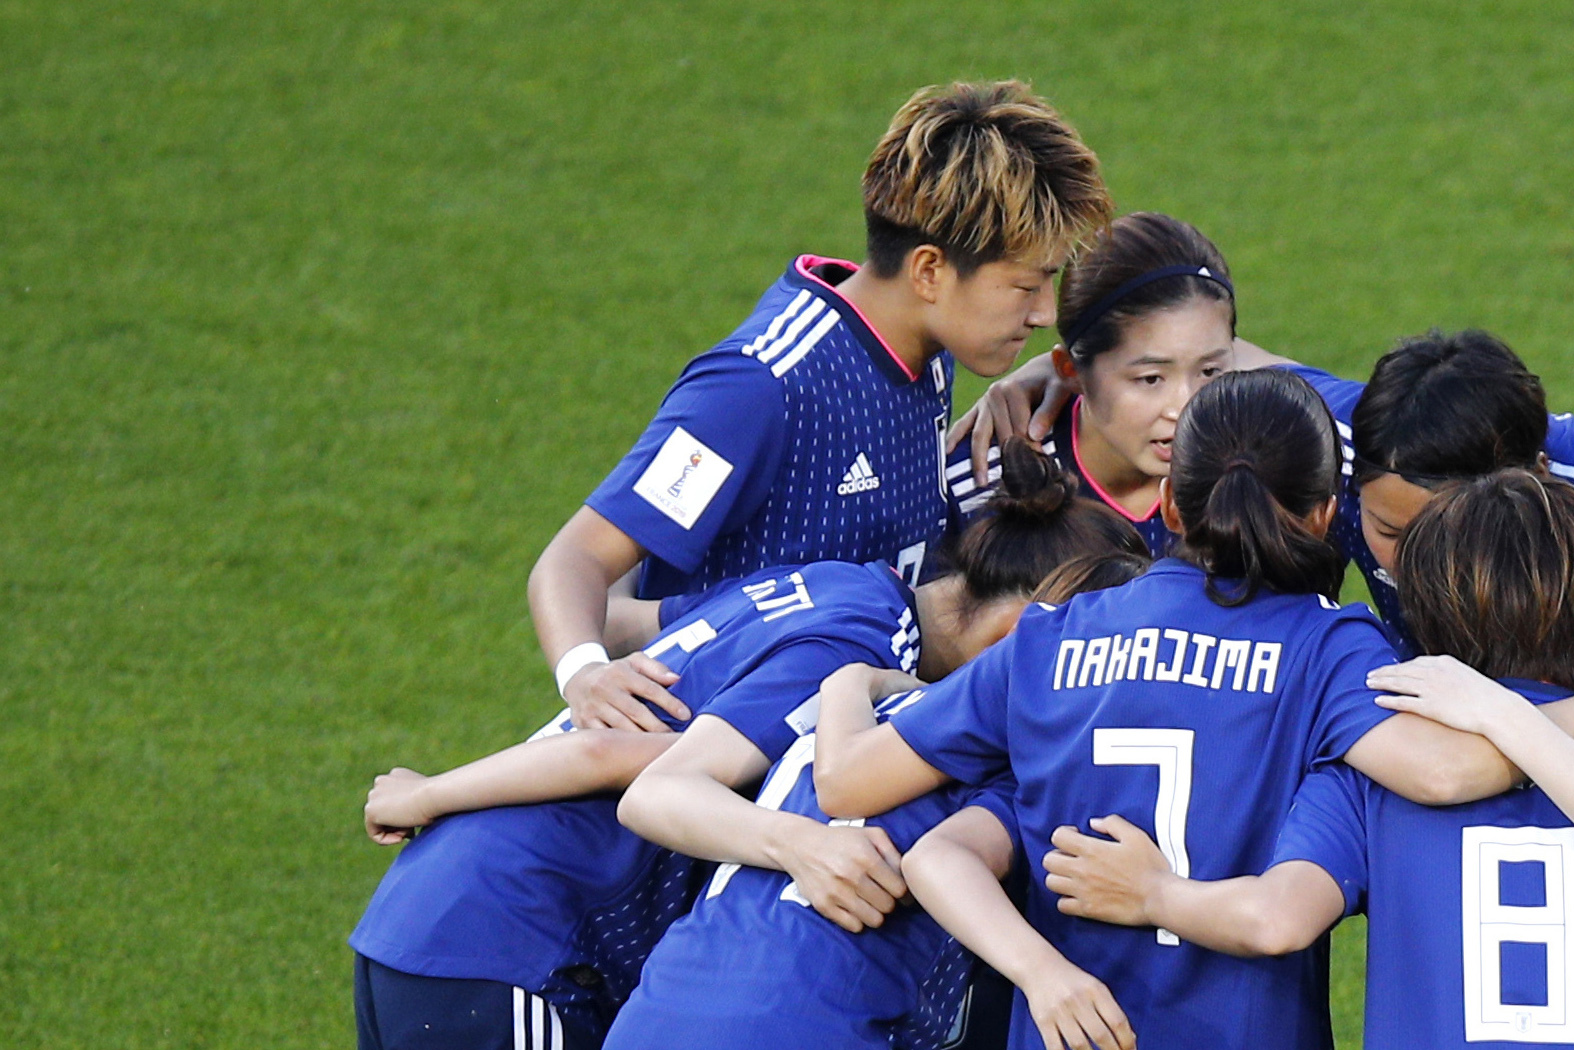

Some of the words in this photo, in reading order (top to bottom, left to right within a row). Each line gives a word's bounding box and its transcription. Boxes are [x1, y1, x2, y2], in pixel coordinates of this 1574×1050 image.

[837, 476, 880, 495] adidas
[1053, 627, 1282, 693] NAKAJIMA
[1093, 728, 1195, 946] 7
